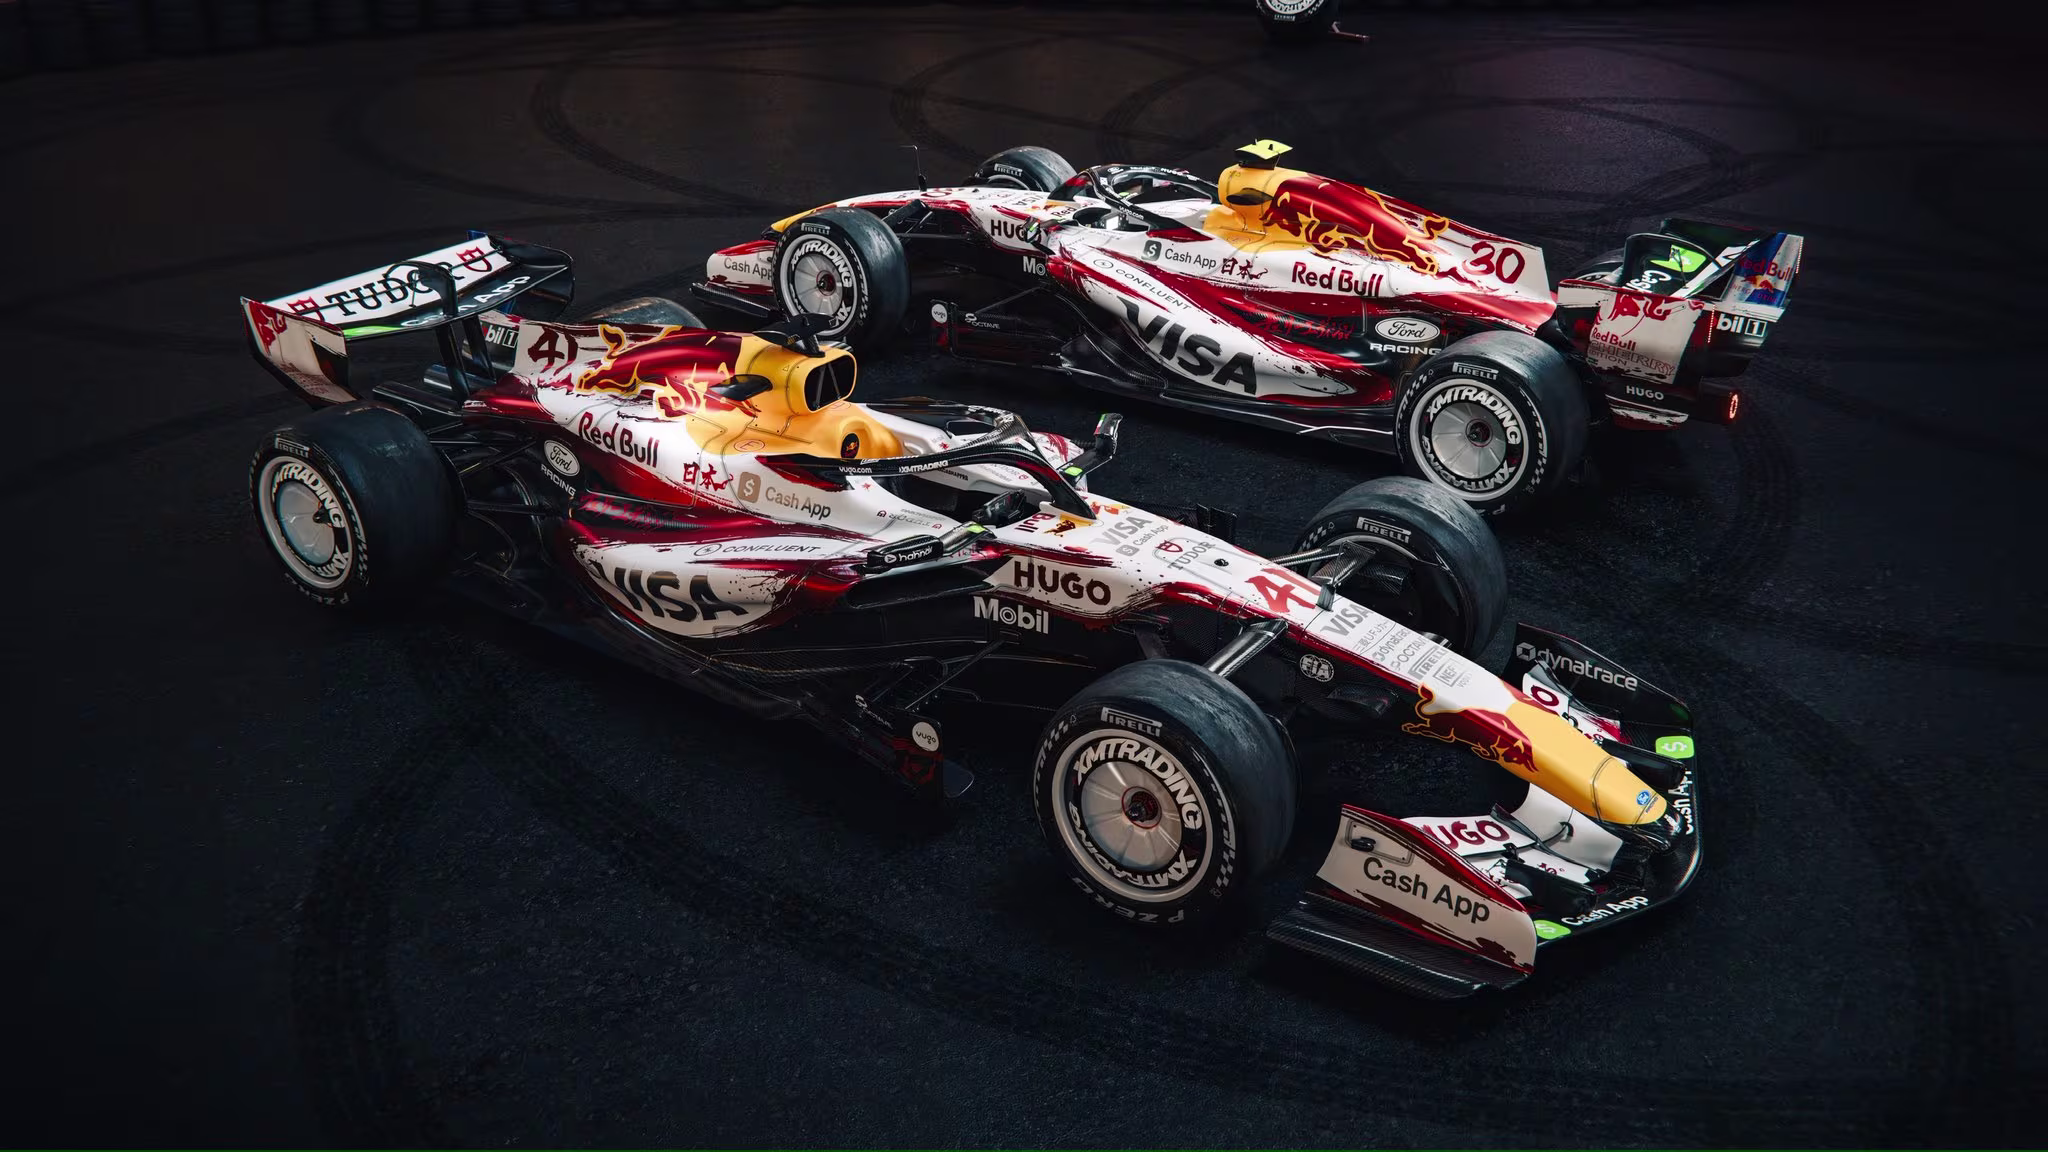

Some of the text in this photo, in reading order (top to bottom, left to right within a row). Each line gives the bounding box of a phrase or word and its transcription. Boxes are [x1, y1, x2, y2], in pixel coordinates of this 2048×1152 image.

[724, 256, 751, 273] Cash
[791, 241, 853, 288] XMTRADING
[1164, 248, 1217, 270] Cash App
[1462, 241, 1525, 284] 30
[1767, 261, 1793, 281] Bull
[473, 276, 531, 303] App
[1115, 268, 1193, 311] CONFLUENT
[1291, 261, 1384, 298] Red Bull
[1116, 295, 1257, 396] VISA
[1388, 321, 1426, 338] Ford
[1591, 327, 1637, 351] Red Bull
[527, 325, 579, 377] 41
[1452, 362, 1498, 381] PIRELLI
[1626, 385, 1665, 400] HUGO
[1426, 386, 1522, 445] XMTRADING
[578, 411, 660, 468] Red Bull
[550, 445, 573, 471] Ford
[839, 466, 873, 476] vugo.com
[900, 460, 949, 474] XMTRADING
[541, 463, 576, 497] RACING
[765, 485, 832, 520] Cash App
[1014, 512, 1056, 534] Bull
[1089, 516, 1154, 546] VISA
[1133, 524, 1169, 546] Cash App
[1357, 516, 1412, 544] PIRELLI
[722, 545, 821, 554] CONFLUENT
[1167, 541, 1216, 571] TUDOR
[588, 558, 749, 623] VISA
[1013, 560, 1112, 606] HUGO
[1244, 568, 1321, 613] 41
[974, 596, 1049, 634] Mobil
[1320, 602, 1374, 637] VISA
[1537, 649, 1639, 692] dynatrace
[1101, 707, 1162, 737] PIRELLI
[1073, 738, 1203, 830] XMTRADING
[1068, 801, 1198, 888] XMTRADING
[1071, 876, 1185, 924] P ZERO
[1363, 856, 1490, 924] Cash App
[1561, 895, 1649, 926] Cash App
